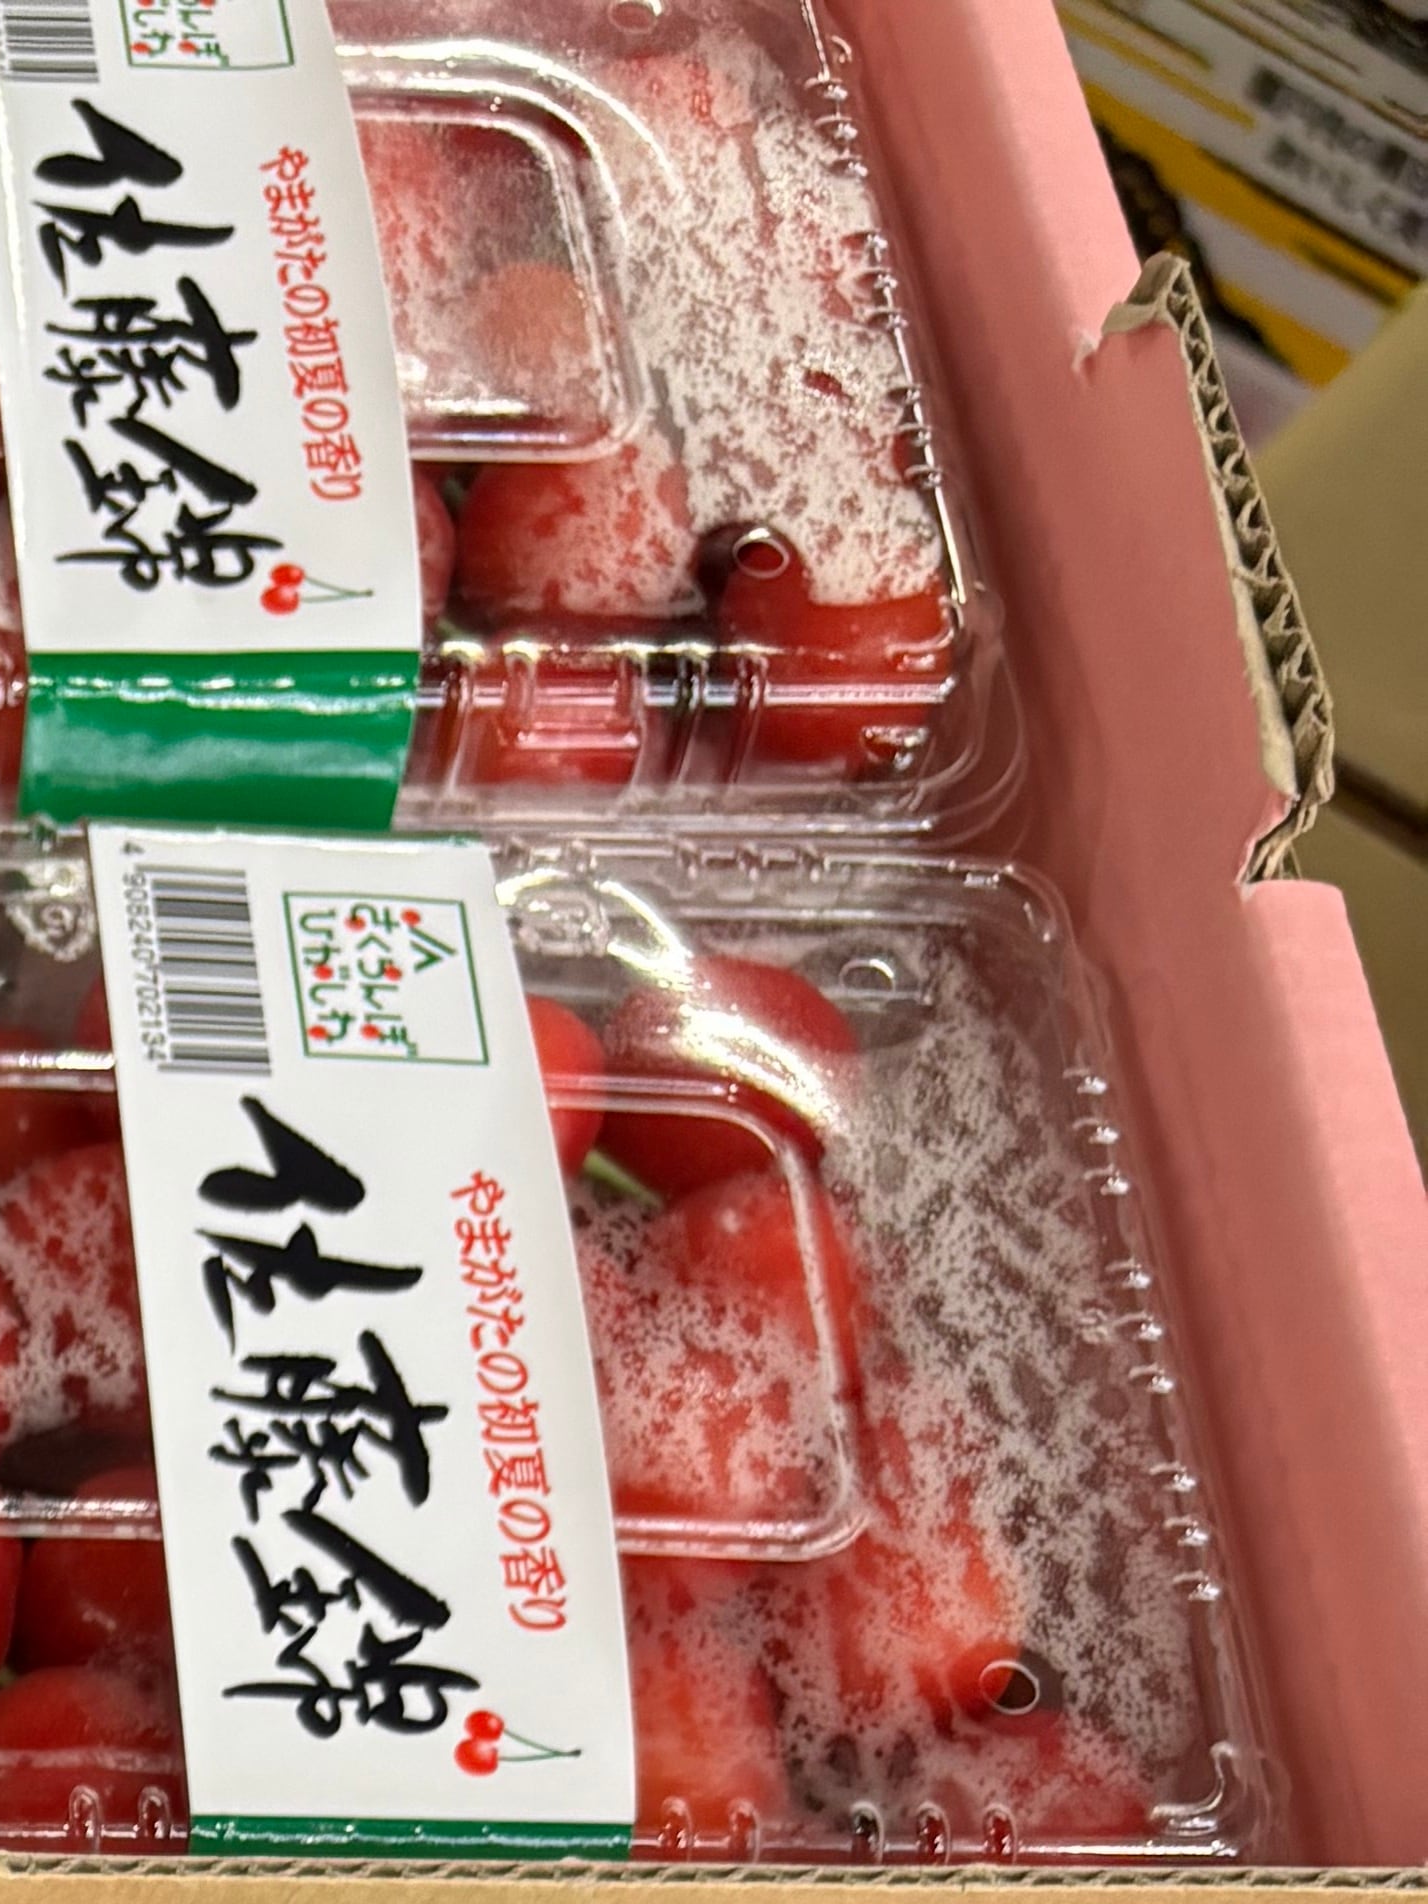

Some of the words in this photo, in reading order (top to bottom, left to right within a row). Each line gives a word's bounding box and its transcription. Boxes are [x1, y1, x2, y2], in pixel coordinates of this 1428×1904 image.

[36, 100, 282, 590] 佐藤錦
[259, 145, 363, 501] やまがたの初夏の香り
[345, 903, 418, 1057] さくらんぼ
[200, 1097, 479, 1737] 佐藤錦
[450, 1170, 568, 1632] やまがたの初夏の香り
